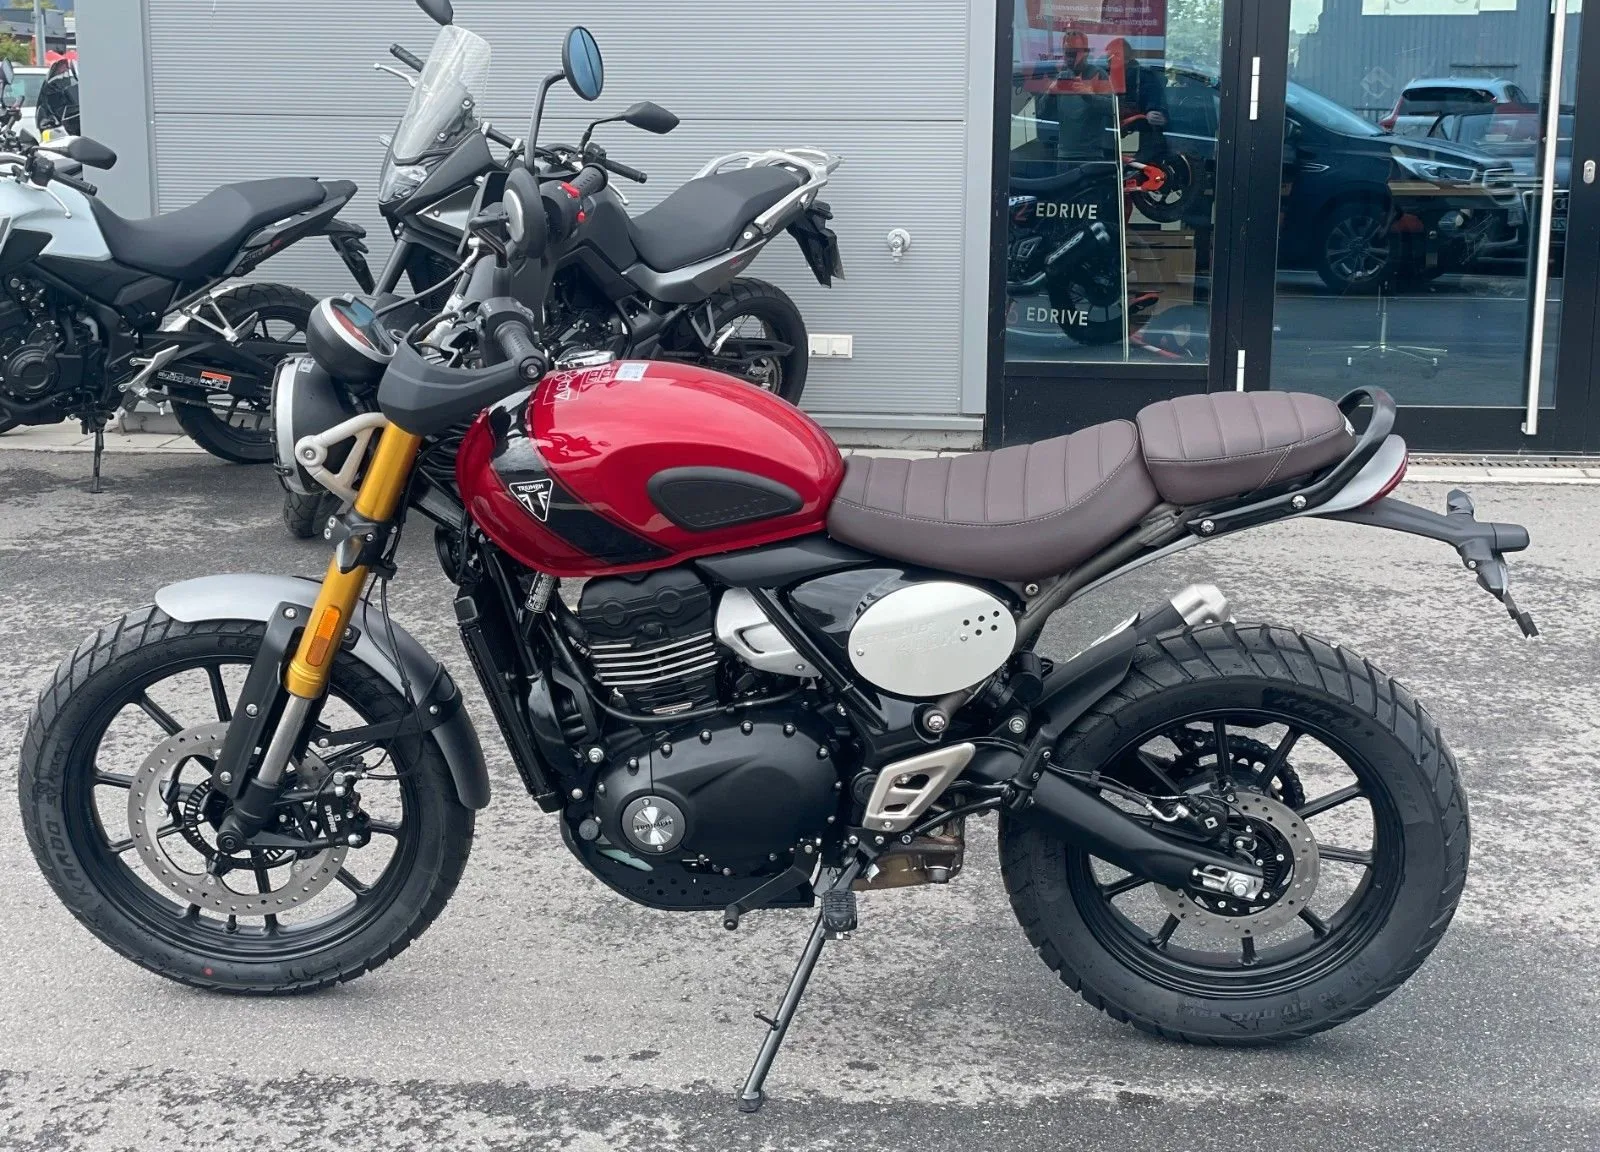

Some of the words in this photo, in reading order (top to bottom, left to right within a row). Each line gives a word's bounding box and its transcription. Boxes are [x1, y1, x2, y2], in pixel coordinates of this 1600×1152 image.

[1035, 202, 1099, 220] EDRIVE
[1026, 307, 1089, 327] EDRIVE
[517, 483, 544, 493] TRIUMPH
[324, 804, 338, 833] BYBRE
